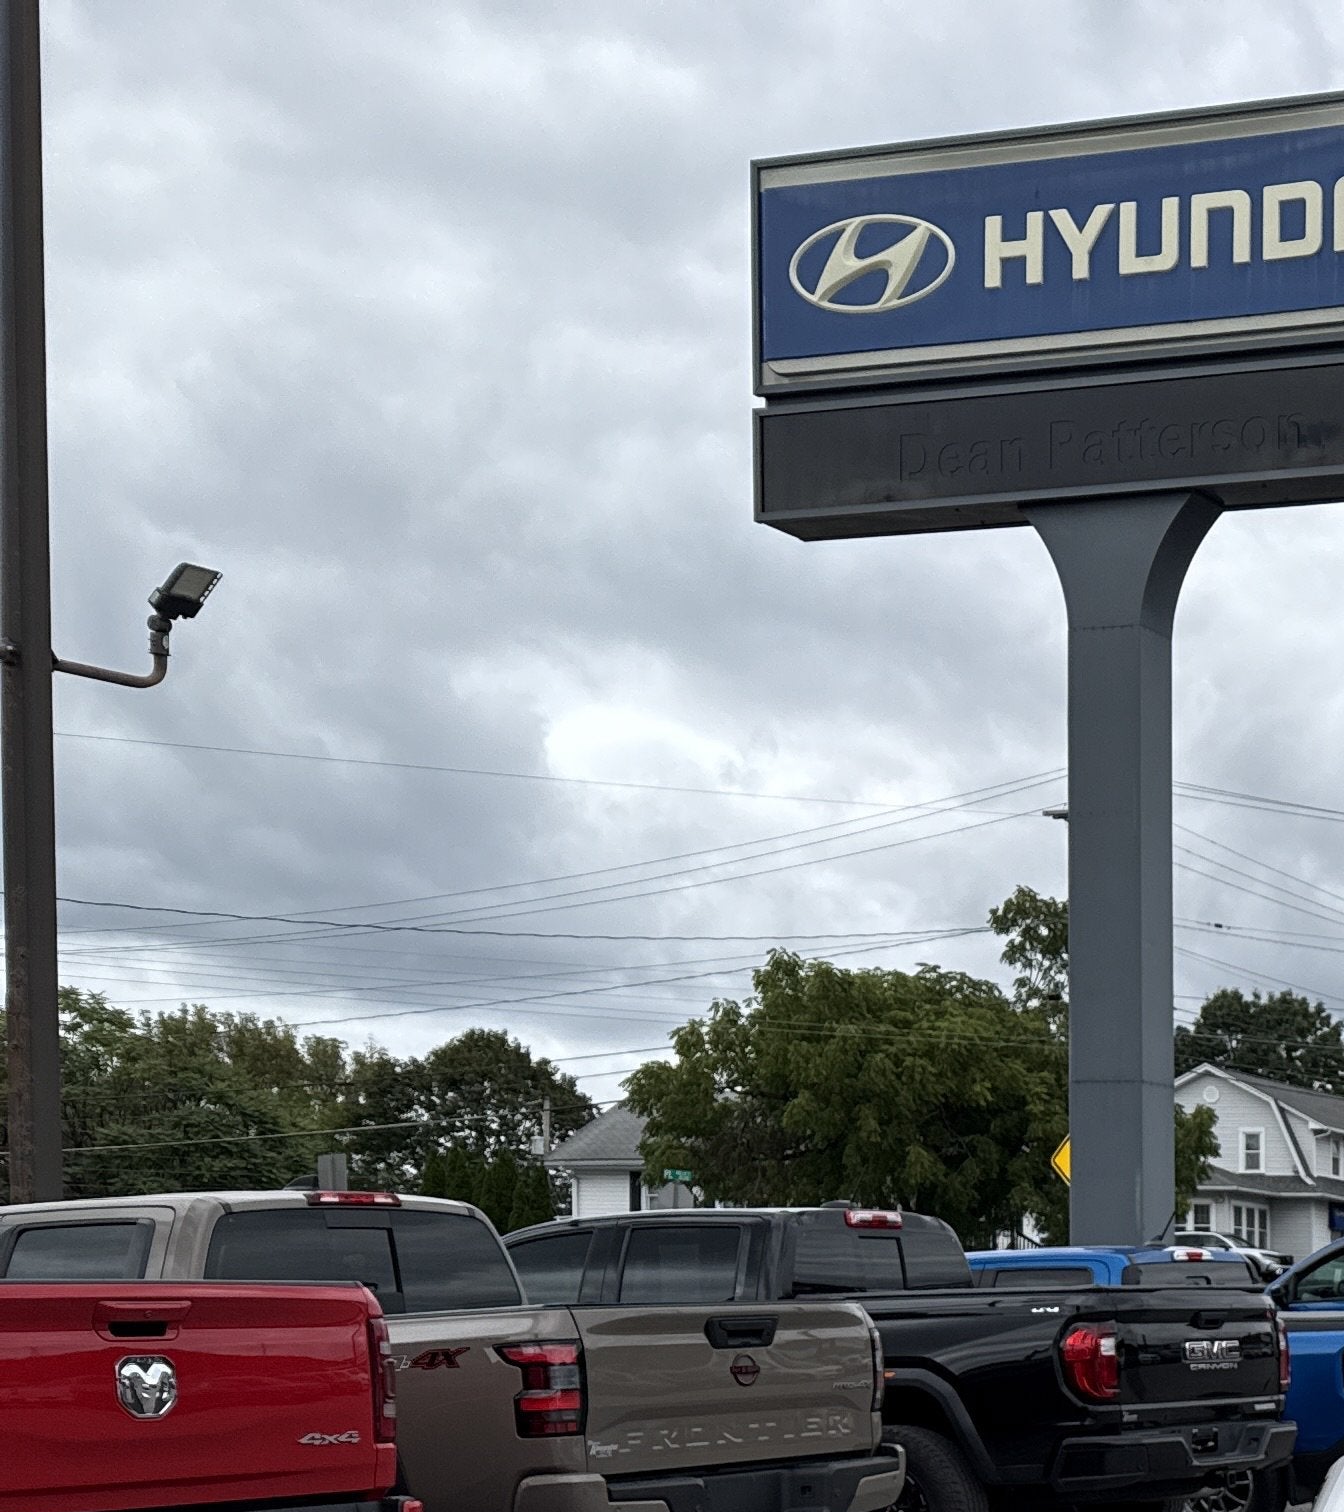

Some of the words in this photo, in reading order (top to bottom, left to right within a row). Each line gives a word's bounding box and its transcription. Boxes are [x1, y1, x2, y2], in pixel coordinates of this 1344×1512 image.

[898, 431, 1023, 481] Dean
[1048, 411, 1304, 469] Patterson
[1184, 1340, 1241, 1361] GMC
